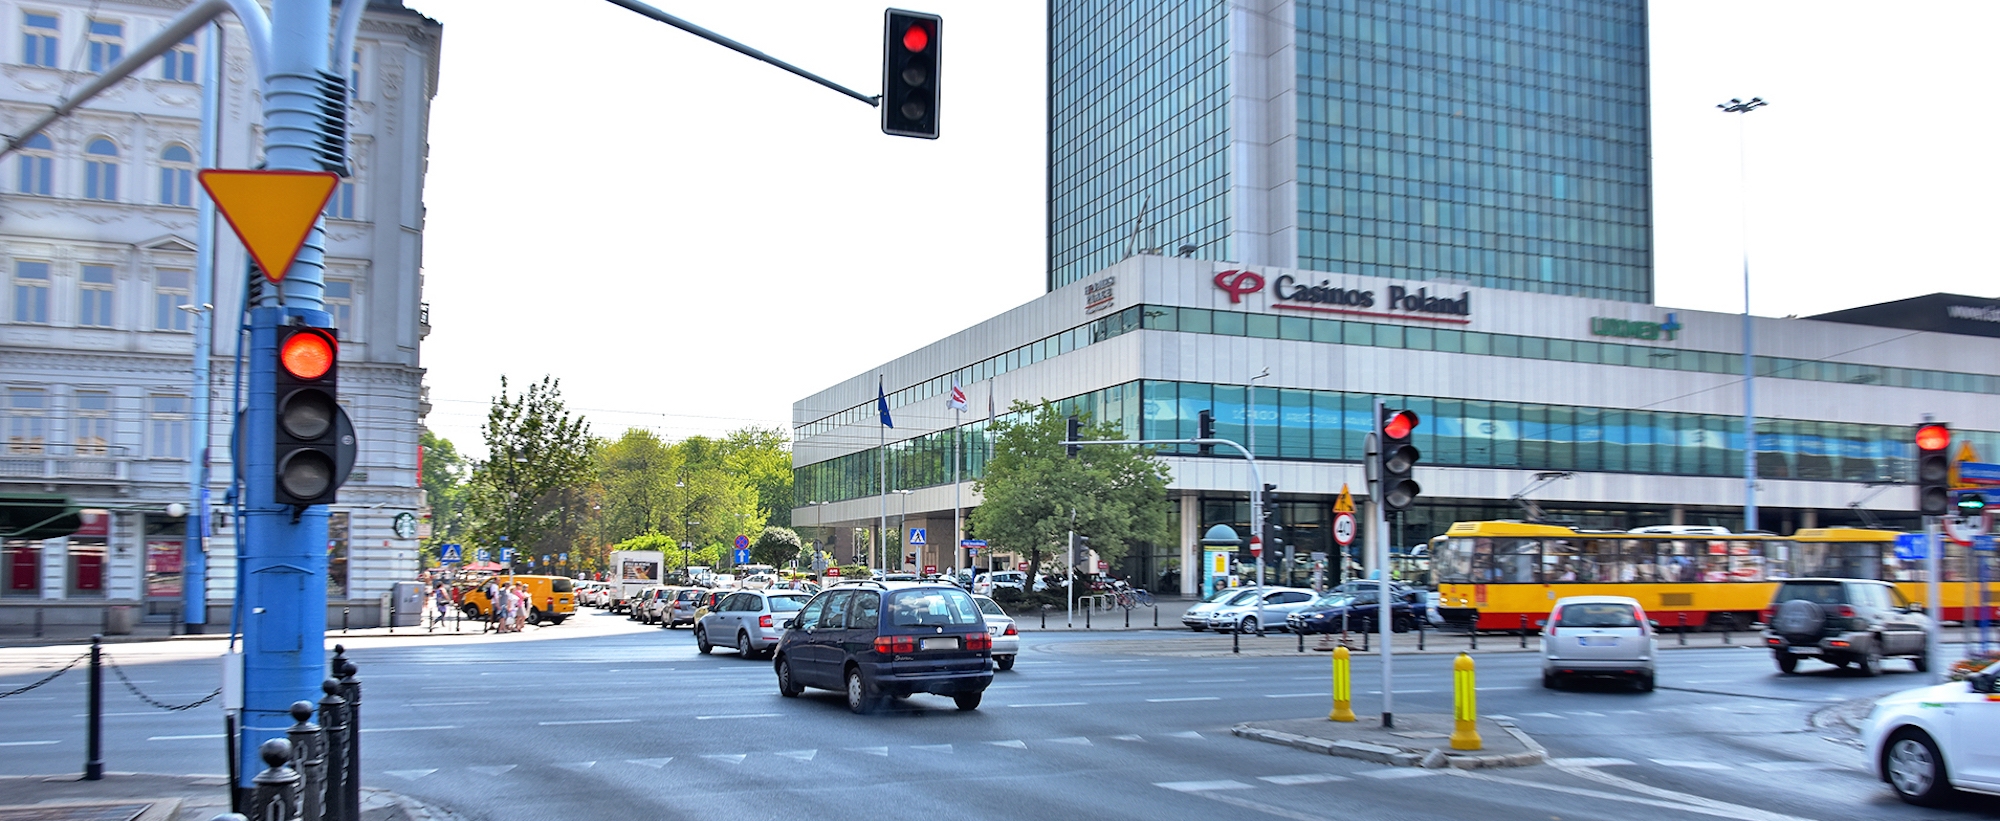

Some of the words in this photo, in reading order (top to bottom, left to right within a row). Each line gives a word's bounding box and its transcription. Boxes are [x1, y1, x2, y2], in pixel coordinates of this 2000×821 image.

[1274, 274, 1374, 308] Casinos
[1388, 284, 1470, 316] Poland
[1336, 520, 1352, 536] 40
